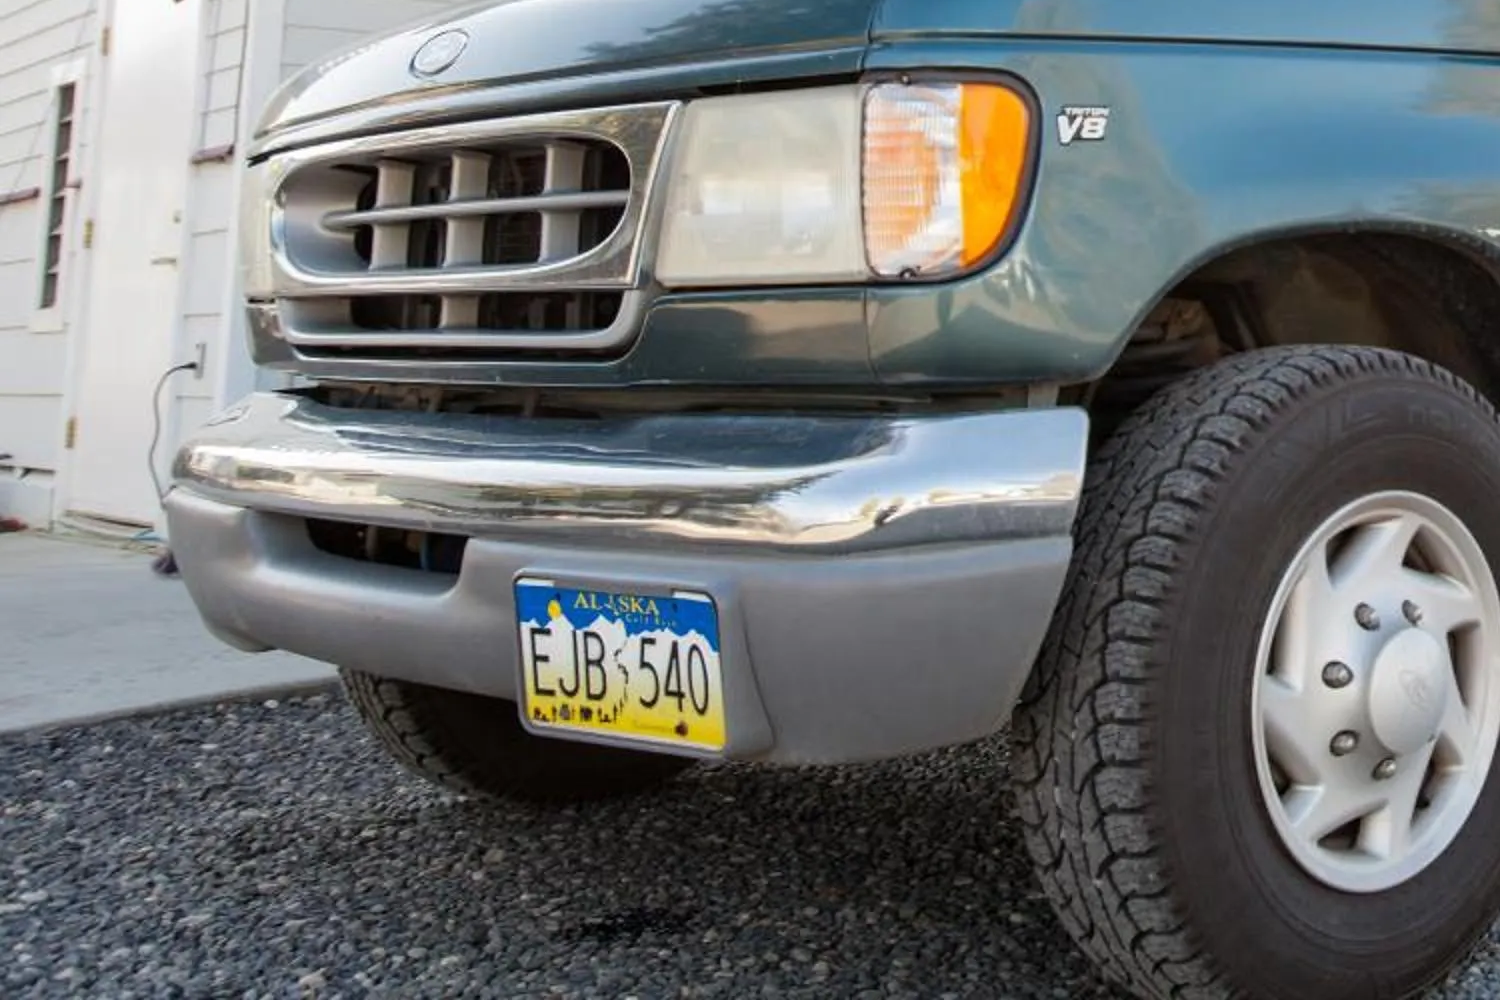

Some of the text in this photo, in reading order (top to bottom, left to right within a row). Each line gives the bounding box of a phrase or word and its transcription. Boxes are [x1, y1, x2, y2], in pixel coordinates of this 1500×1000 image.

[1057, 114, 1108, 144] V8
[573, 590, 661, 617] ALASKA
[529, 627, 710, 717] EJB 540
